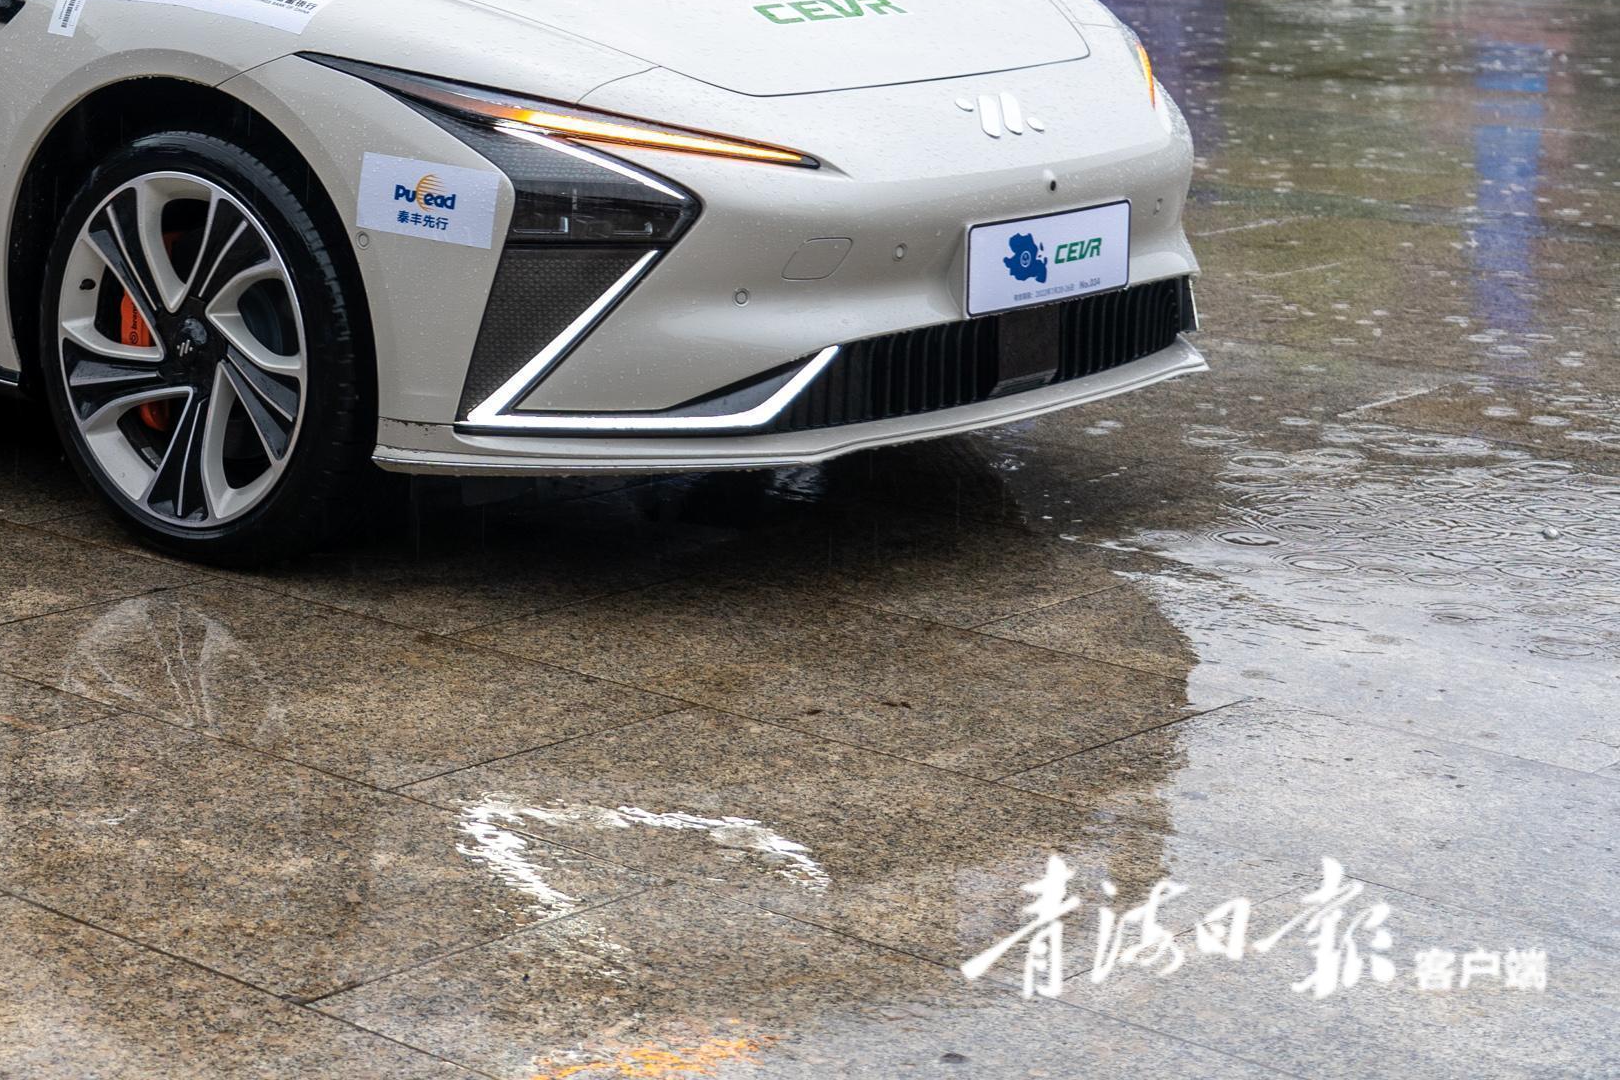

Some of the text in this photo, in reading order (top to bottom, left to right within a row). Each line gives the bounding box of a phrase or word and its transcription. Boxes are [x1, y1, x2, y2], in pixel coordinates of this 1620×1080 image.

[397, 210, 449, 231] 泰丰先行
[1054, 237, 1102, 264] CEVR
